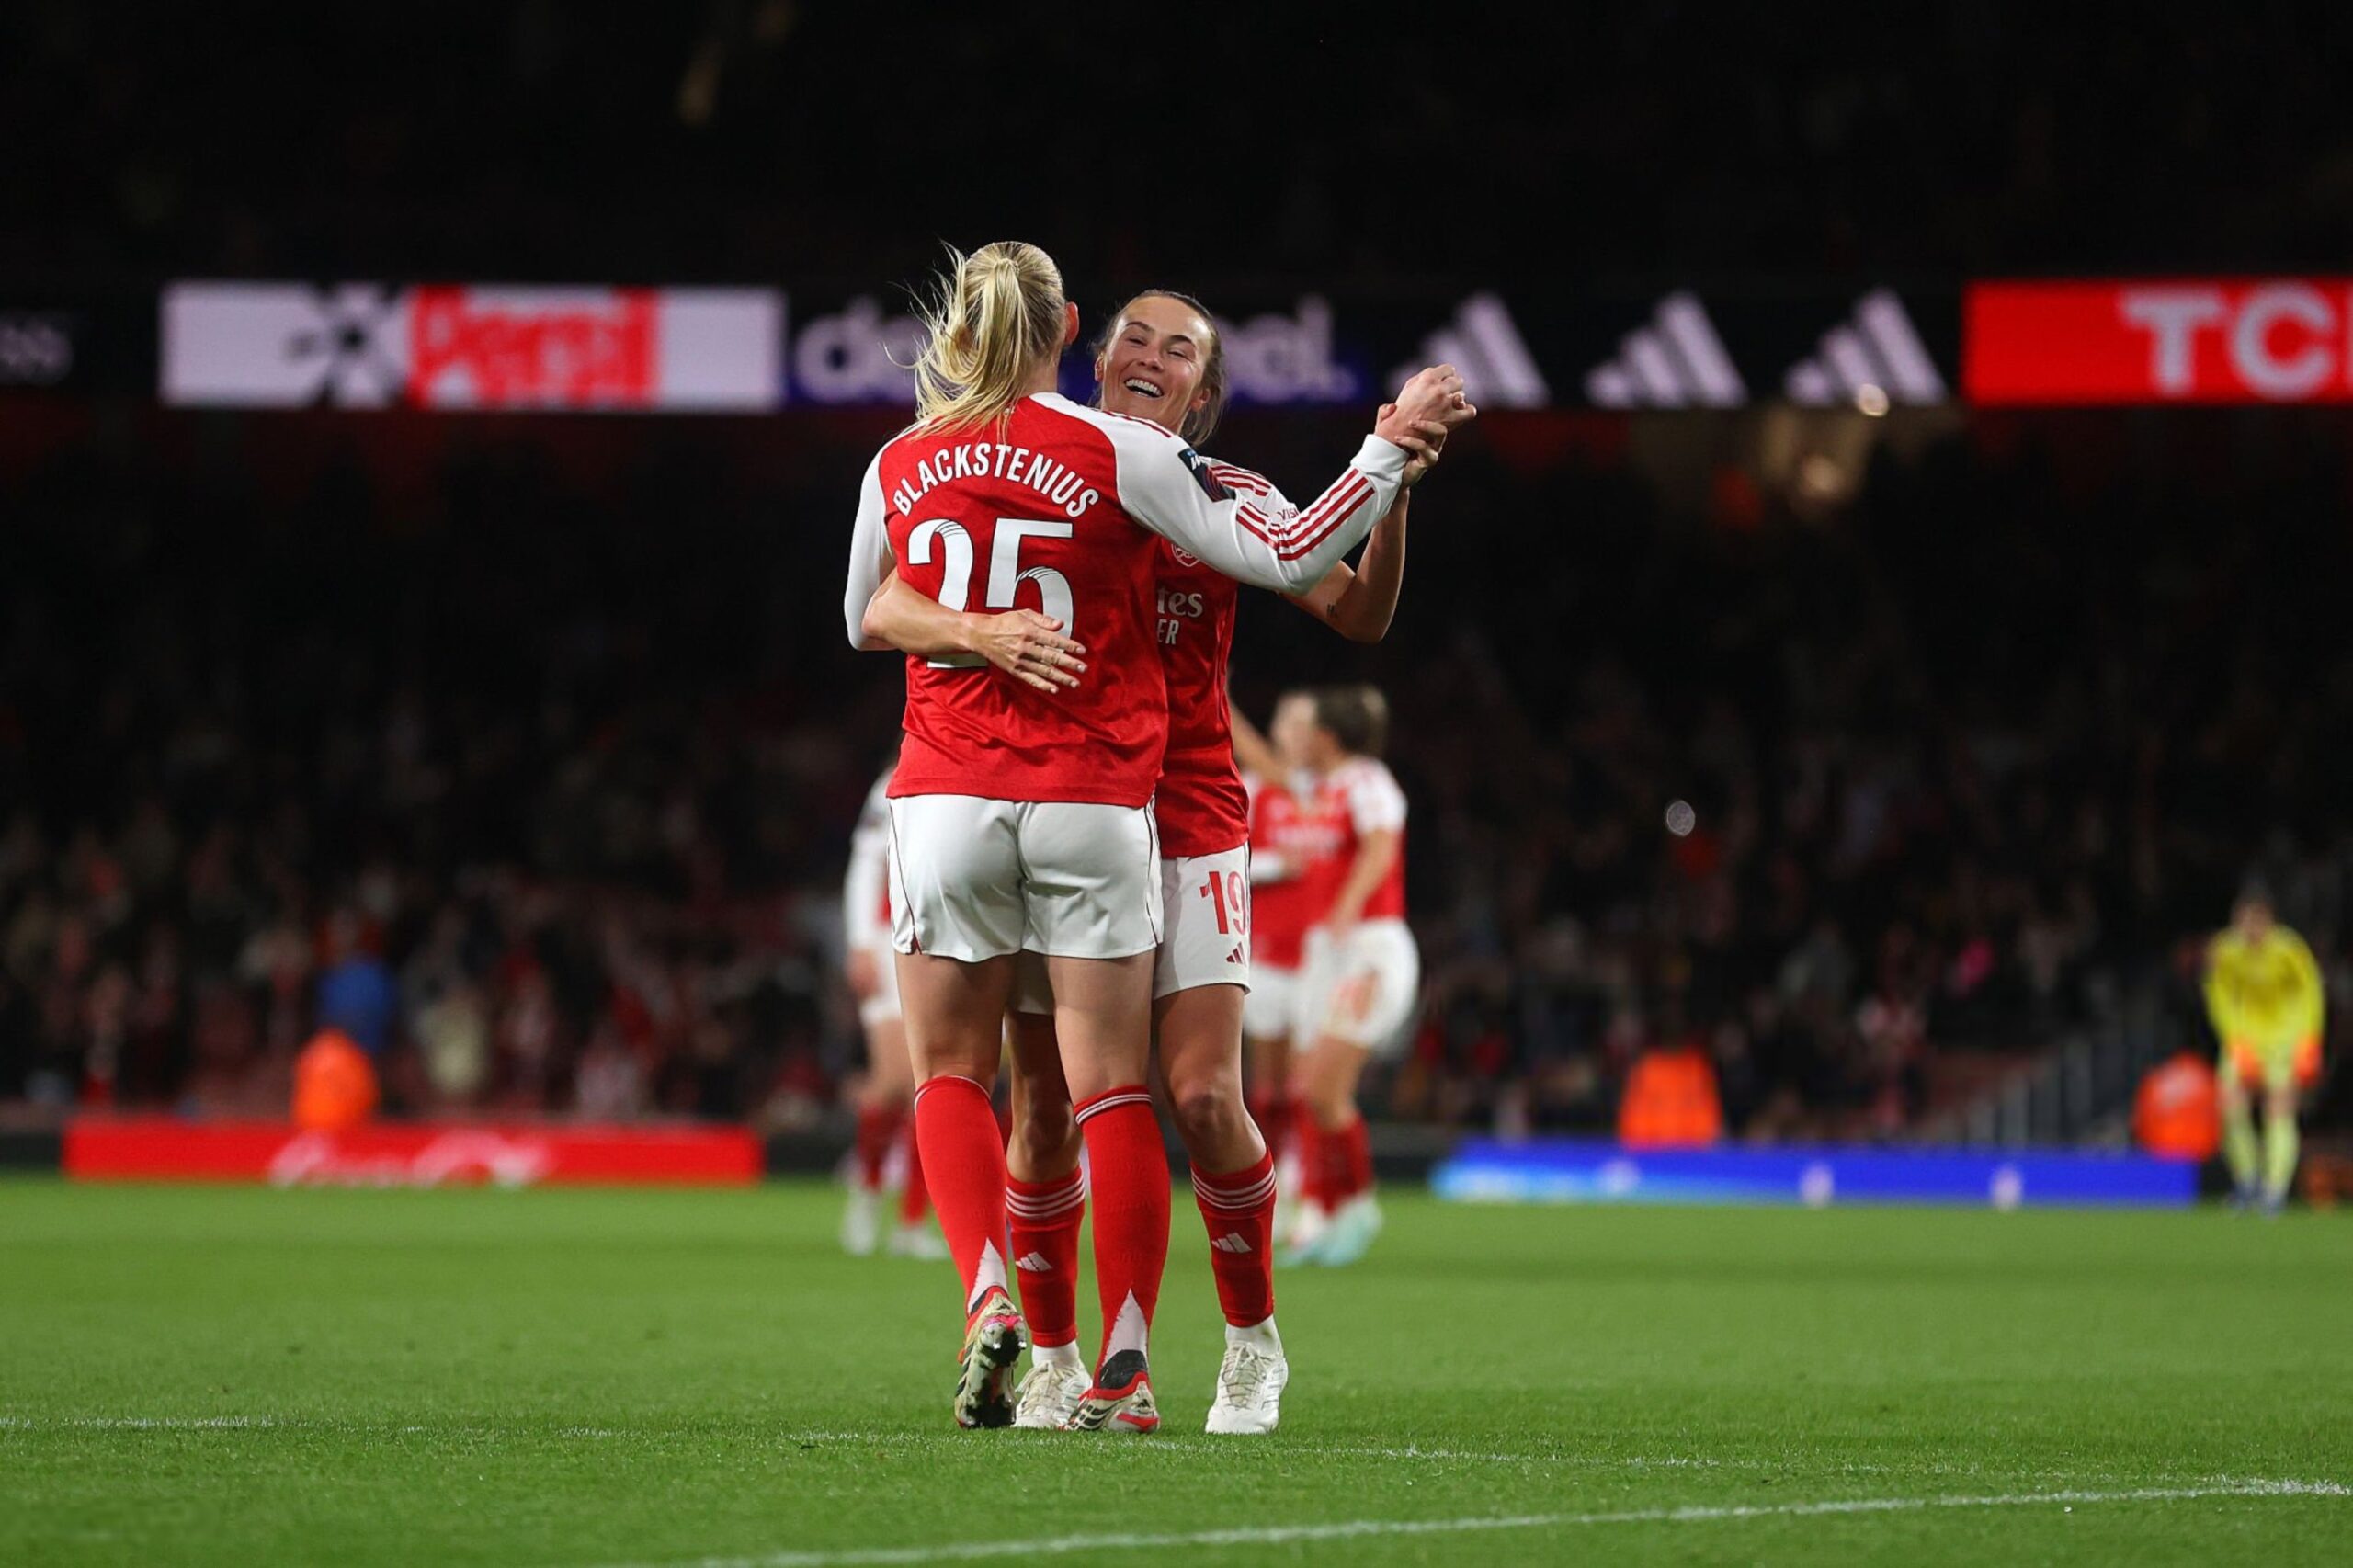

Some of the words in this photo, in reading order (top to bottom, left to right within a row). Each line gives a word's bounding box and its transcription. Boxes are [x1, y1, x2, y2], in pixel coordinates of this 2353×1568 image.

[2120, 280, 2353, 401] TC
[892, 443, 1099, 517] BLACKSTENIUS
[907, 517, 1074, 669] 25
[1199, 870, 1246, 935] 19
